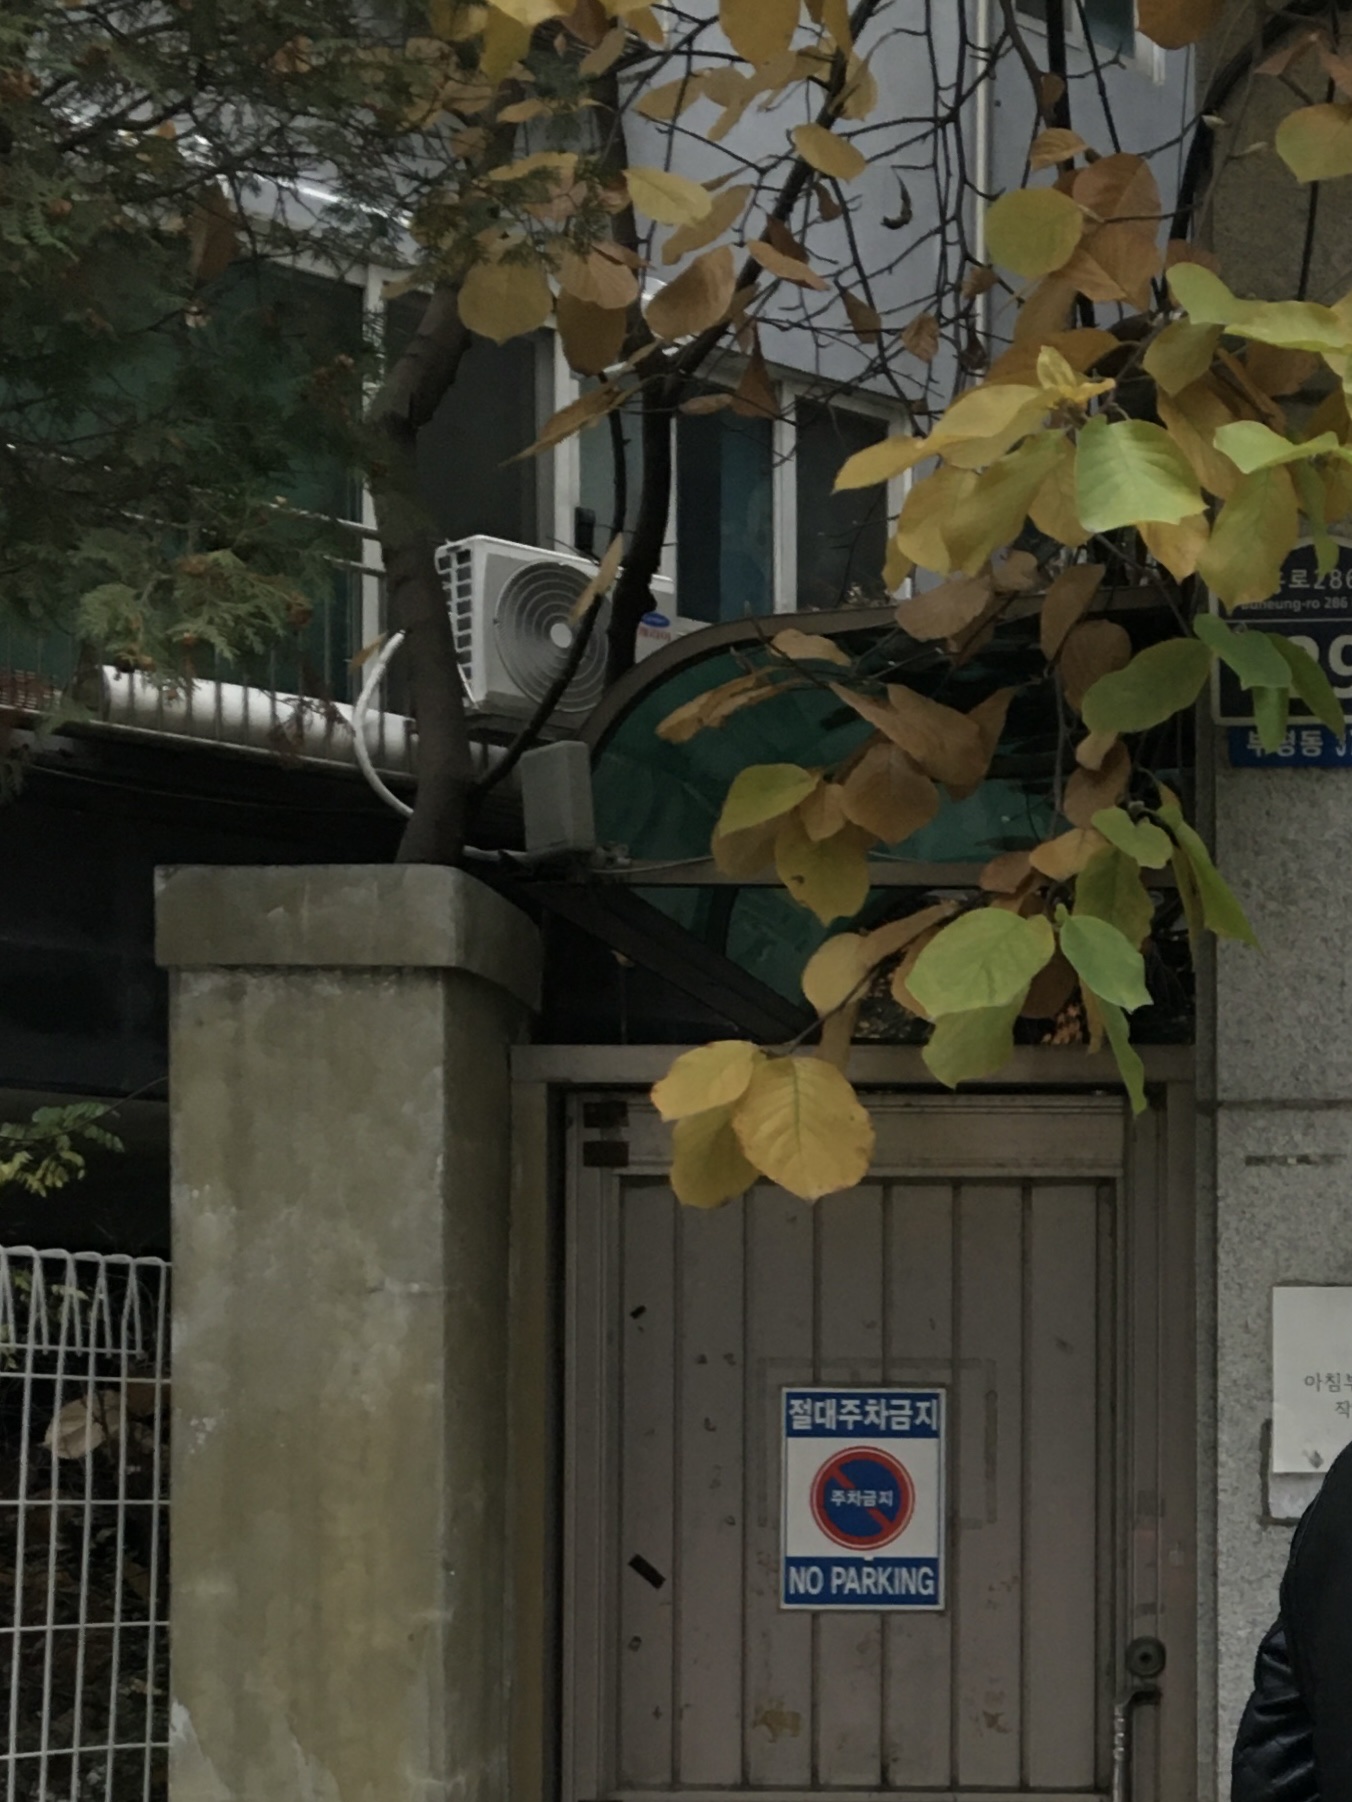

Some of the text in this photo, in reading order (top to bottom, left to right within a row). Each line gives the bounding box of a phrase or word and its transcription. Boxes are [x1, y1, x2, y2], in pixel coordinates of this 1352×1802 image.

[1324, 596, 1348, 610] 286
[788, 1398, 938, 1431] 절대주차금지
[830, 1489, 894, 1507] 주차금지
[788, 1566, 935, 1596] NO PARKING
